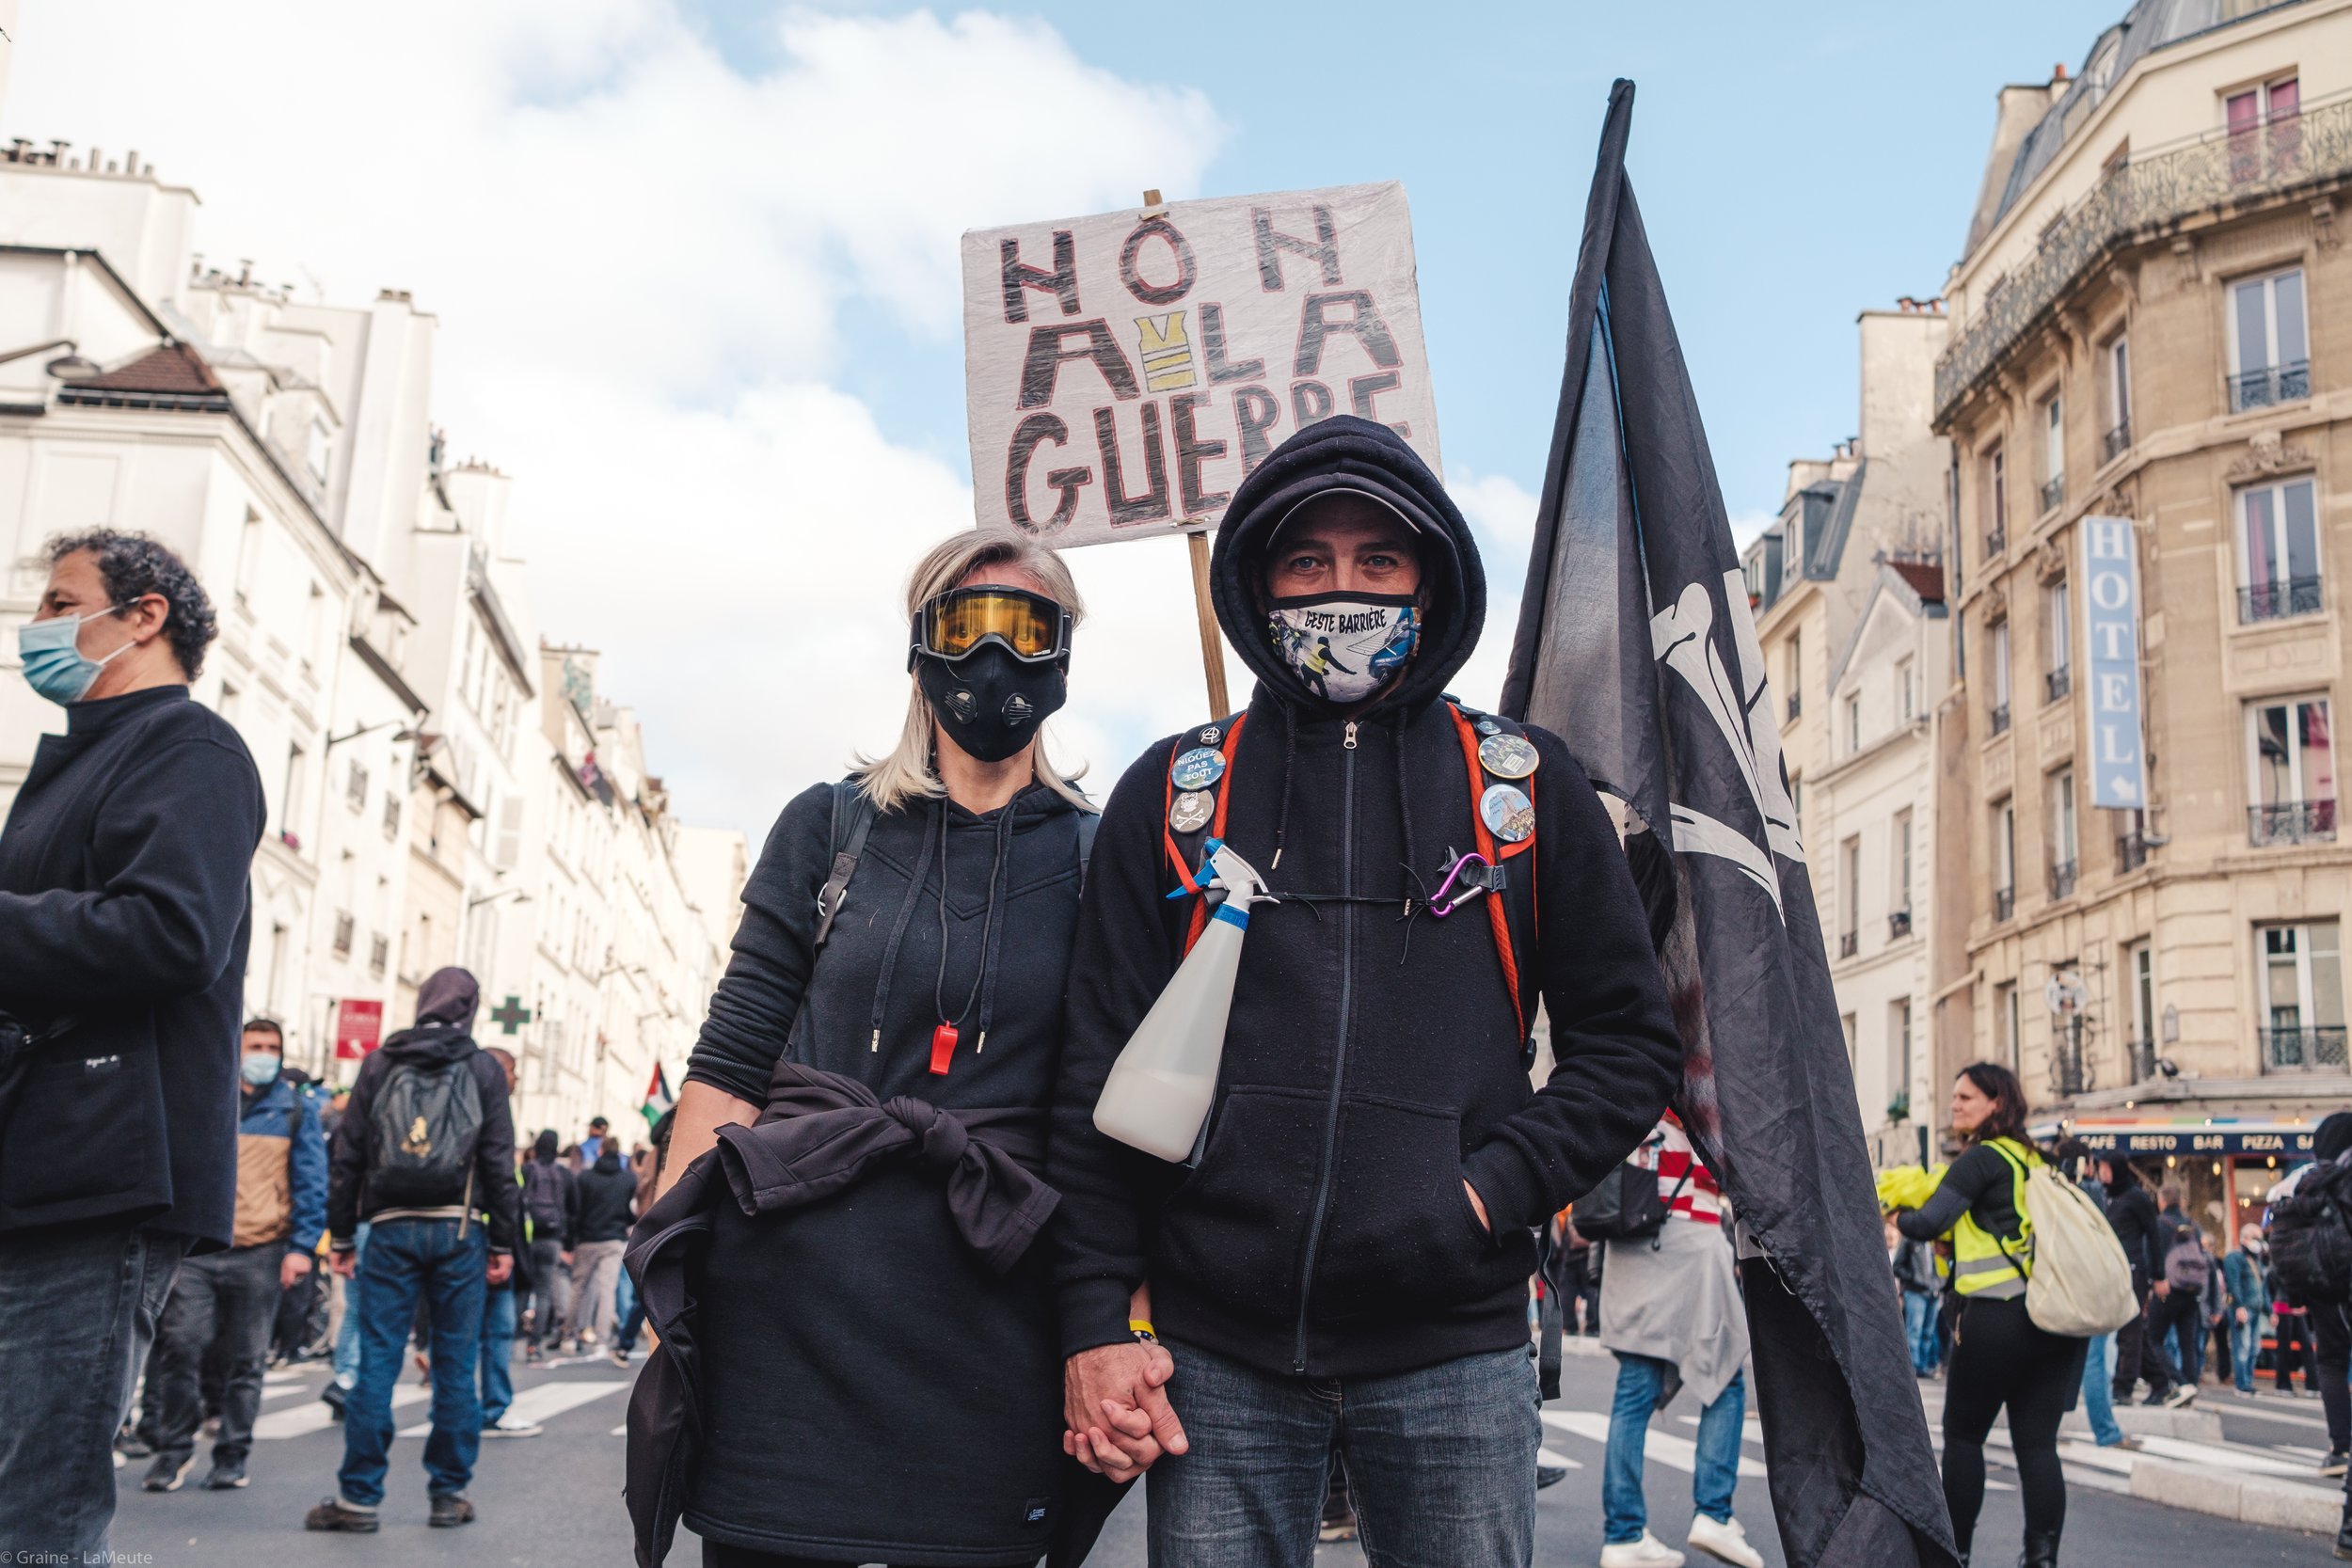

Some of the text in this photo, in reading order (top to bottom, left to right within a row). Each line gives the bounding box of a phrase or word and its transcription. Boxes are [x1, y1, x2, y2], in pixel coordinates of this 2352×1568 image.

[999, 203, 1343, 325] NON
[1017, 289, 1405, 411] A LA
[1305, 607, 1387, 634] GESTE BARRIÈRE
[2089, 520, 2135, 765] HOTEL
[1177, 750, 1216, 767] NIQUEZ
[1187, 761, 1208, 772] PAS
[1183, 768, 1214, 782] TOUT
[2129, 1134, 2178, 1150] RESTO
[2193, 1134, 2225, 1150] BAR
[2242, 1134, 2285, 1150] PIZZA
